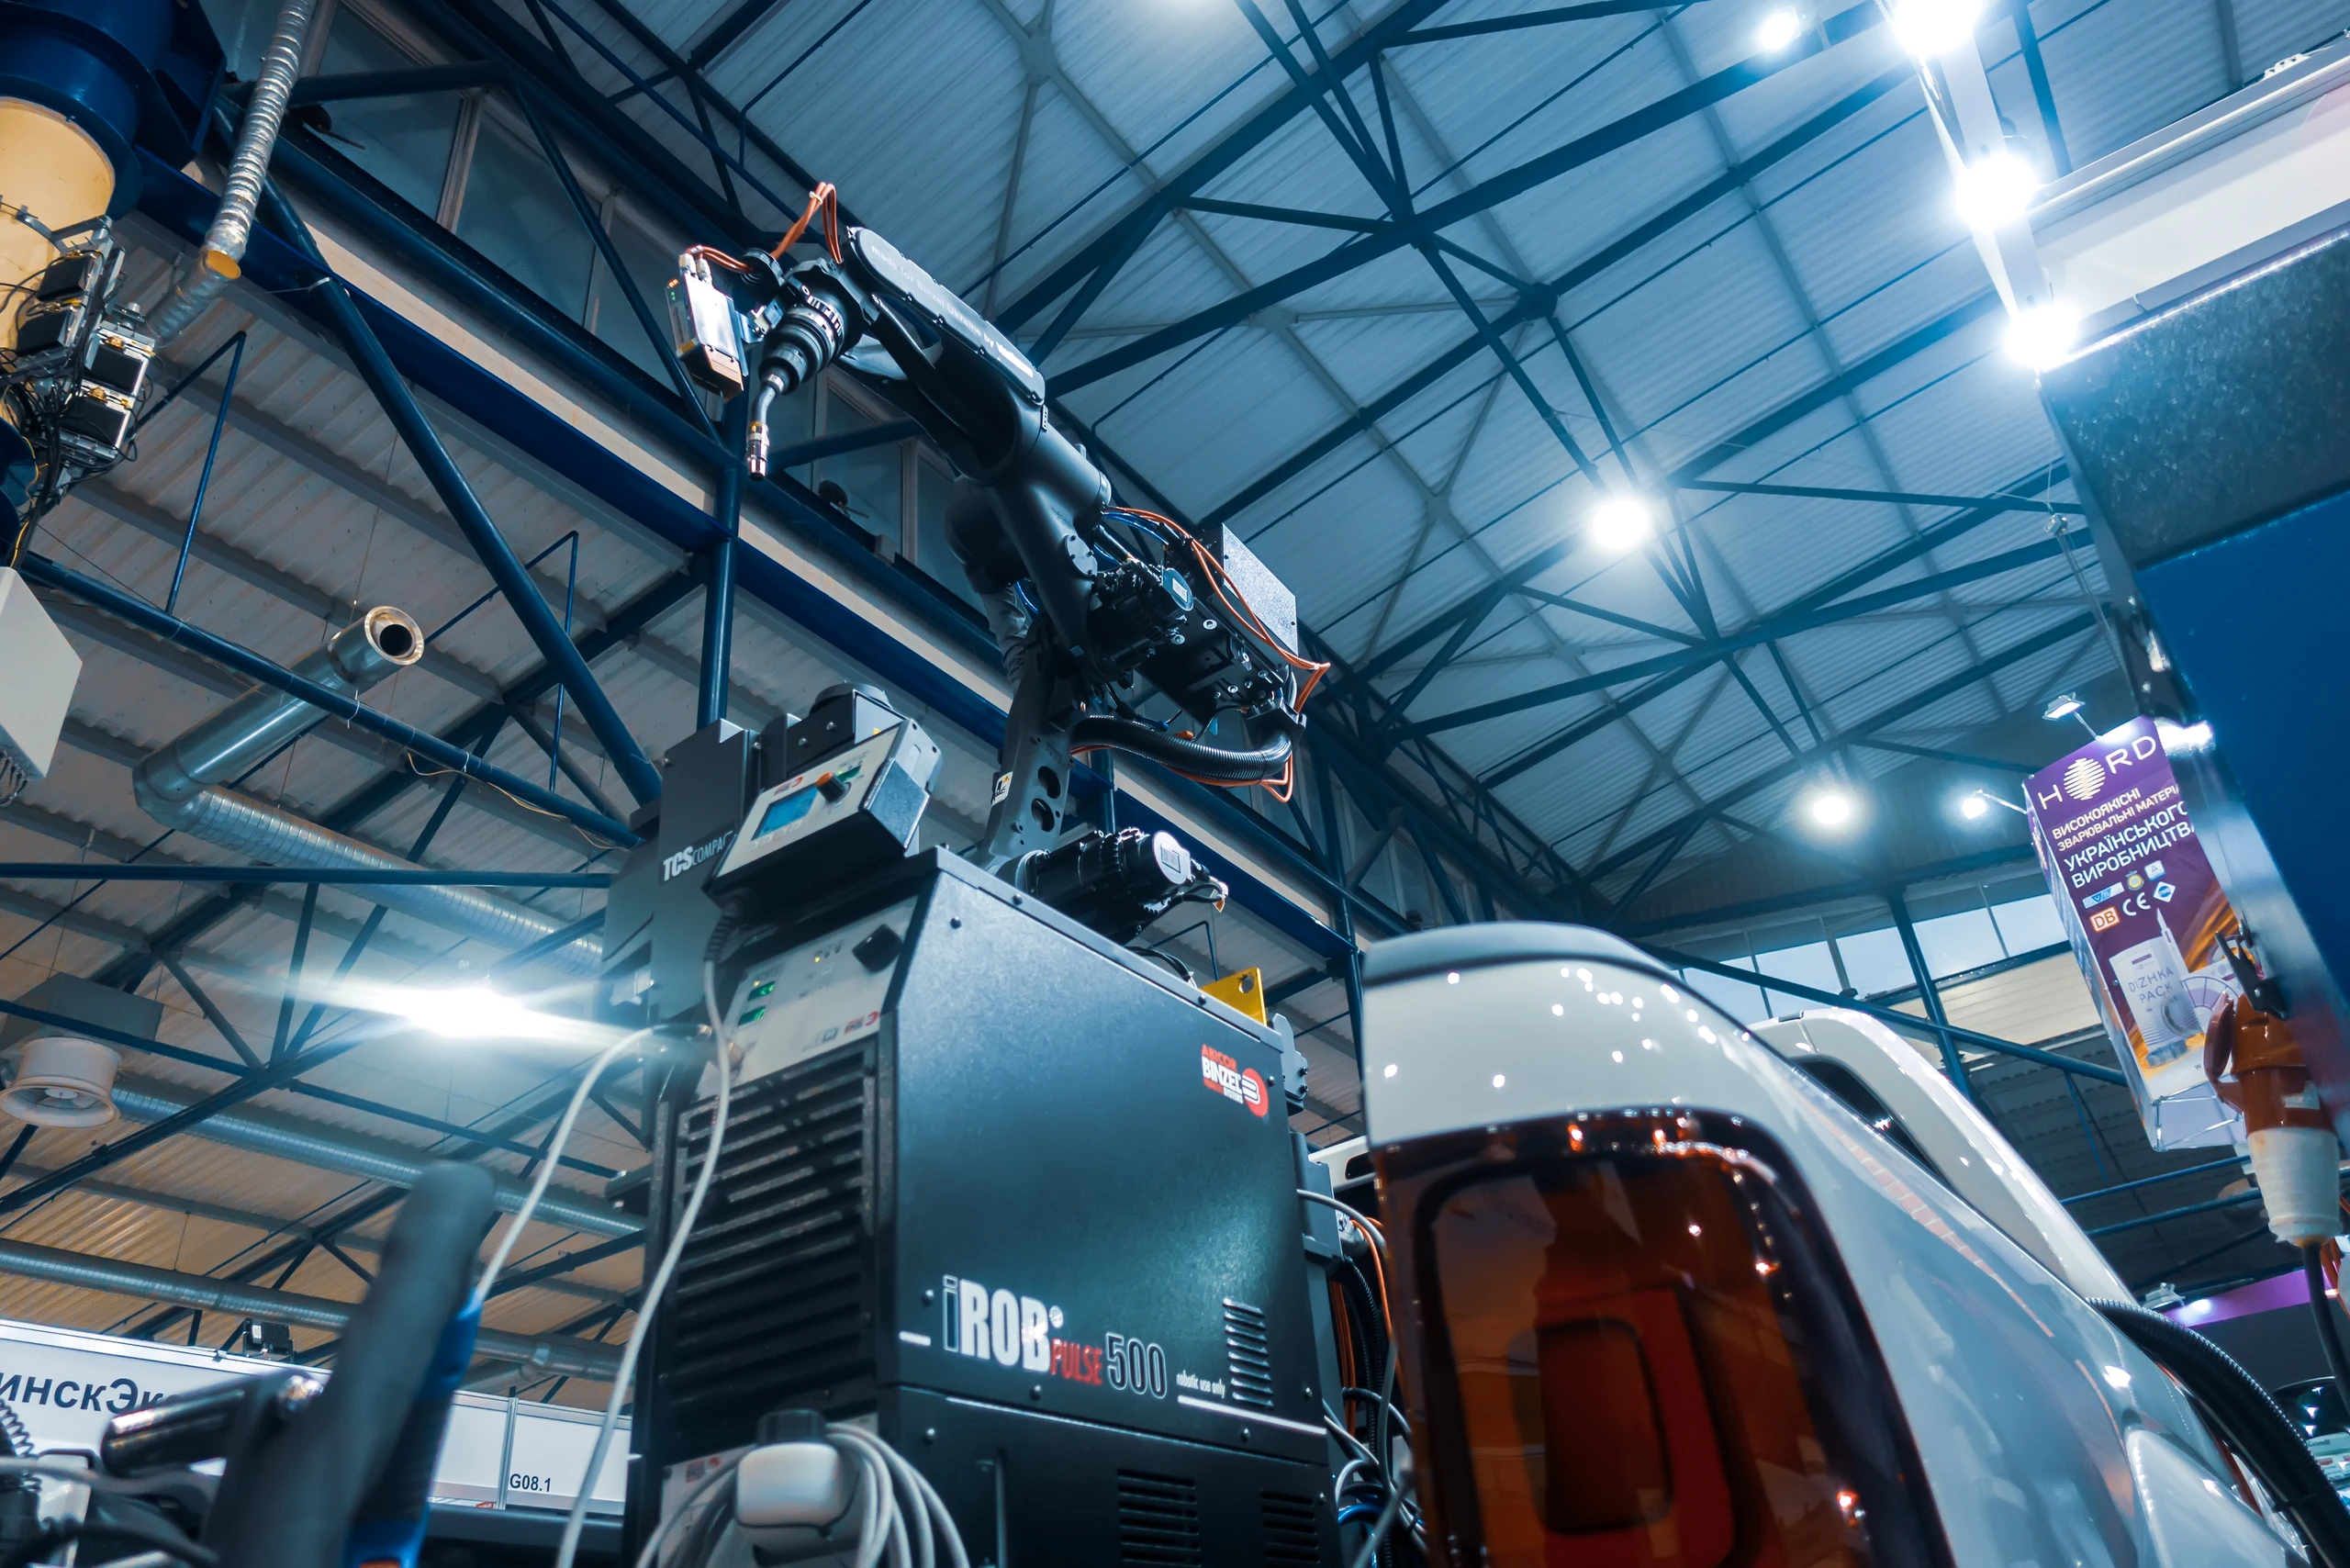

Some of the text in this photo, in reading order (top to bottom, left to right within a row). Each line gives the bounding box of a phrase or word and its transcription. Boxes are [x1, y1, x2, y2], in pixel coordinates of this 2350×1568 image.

[871, 245, 898, 271] made
[900, 267, 915, 283] for
[2052, 787, 2142, 840] ВИСОКОЯКІСНІ
[2057, 807, 2136, 852] ЗВАРЮВАЛЬНІ
[663, 846, 693, 881] TCS
[2094, 911, 2116, 929] DB
[2128, 967, 2175, 992] DIZHKA
[2140, 981, 2173, 1004] PACK
[1202, 1056, 1243, 1095] BINZEL
[1050, 1338, 1102, 1385] PULSE
[1105, 1331, 1168, 1399] 500
[1176, 1369, 1225, 1399] robotic use only
[509, 1473, 551, 1493] G08.1
